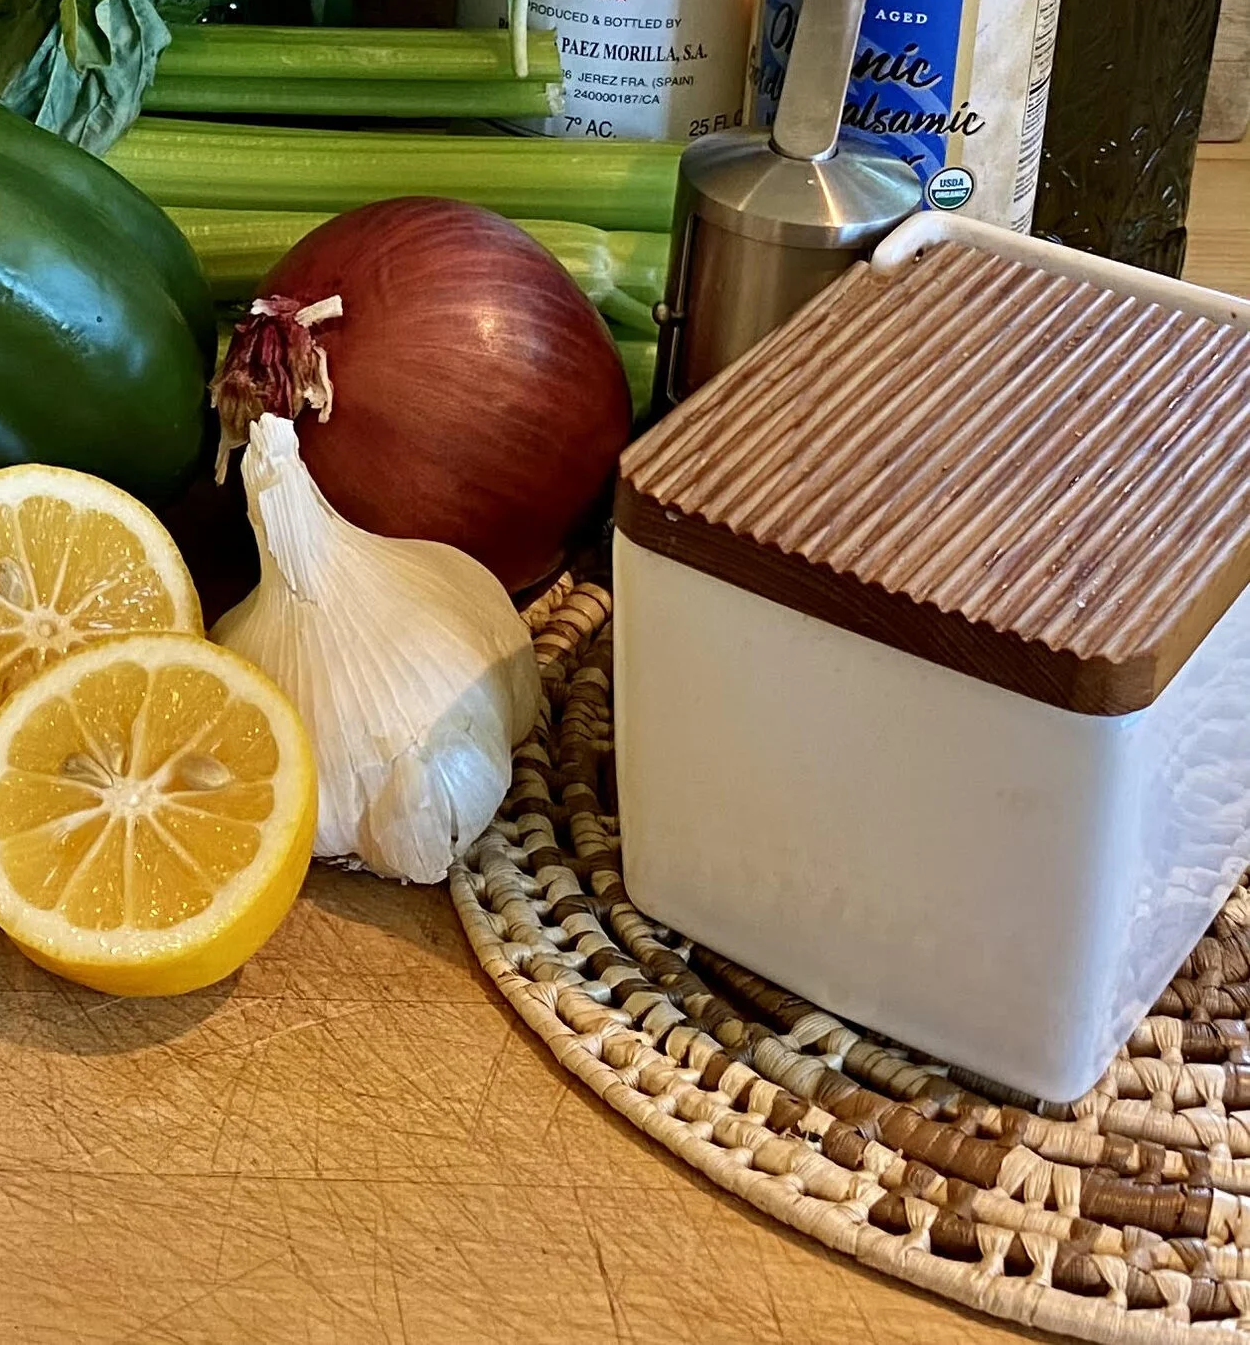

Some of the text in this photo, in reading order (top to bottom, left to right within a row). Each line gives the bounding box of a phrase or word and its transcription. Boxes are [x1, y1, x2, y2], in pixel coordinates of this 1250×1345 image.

[591, 15, 601, 26] &
[604, 16, 662, 29] BOTTLED
[666, 18, 682, 28] BY
[875, 9, 928, 24] AGED
[561, 37, 708, 65] PAEZ MORILLA, S.A.
[577, 72, 618, 86] JEREZ
[652, 76, 694, 89] (SPAIN)
[574, 89, 660, 105] 240000187/CA
[841, 92, 986, 136] alsamic
[585, 120, 617, 139] AC.
[689, 118, 709, 136] 25
[940, 178, 964, 188] USDA
